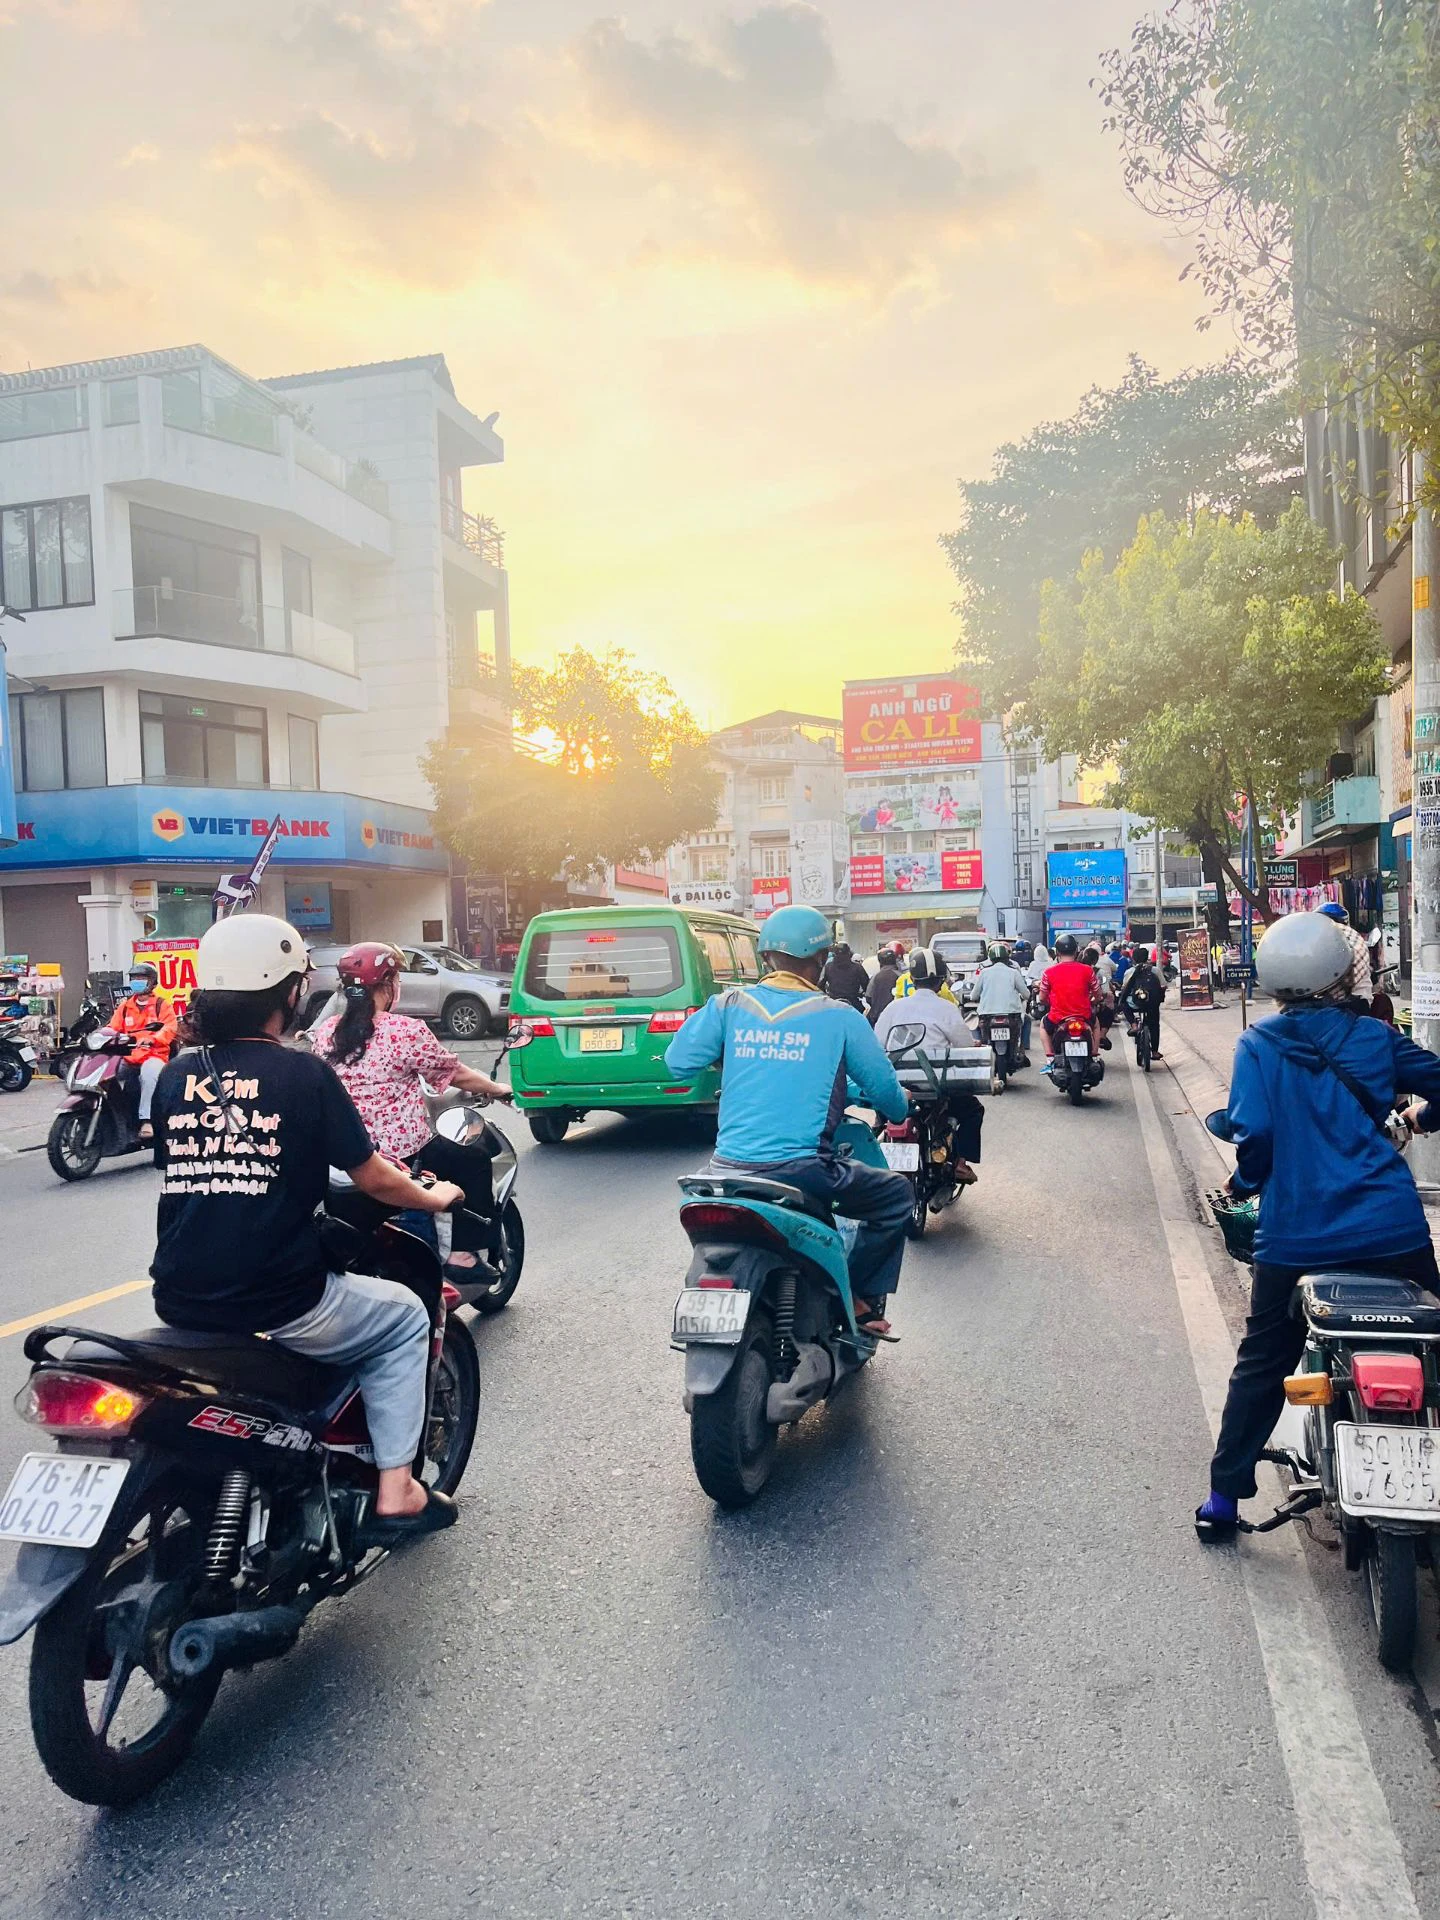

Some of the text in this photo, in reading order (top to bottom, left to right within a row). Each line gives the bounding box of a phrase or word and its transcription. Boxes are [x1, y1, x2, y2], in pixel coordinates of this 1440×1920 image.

[869, 700, 906, 718] ANH
[912, 692, 953, 714] NGỮ
[188, 817, 331, 838] VIETBANK
[376, 828, 434, 849] VIETBANK
[685, 888, 732, 903] ĐẠI LỘC
[144, 954, 198, 990] ỮA
[585, 1040, 618, 1050] 050.83
[592, 1030, 610, 1040] 50F
[734, 1028, 811, 1047] XANH SM
[735, 1044, 805, 1062] xin chào!
[687, 1294, 738, 1315] 59-TA
[1350, 1314, 1415, 1324] HONDA
[26, 1462, 112, 1497] 76-AF
[1362, 1467, 1434, 1502] 7695
[1, 1497, 104, 1538] 040.27
